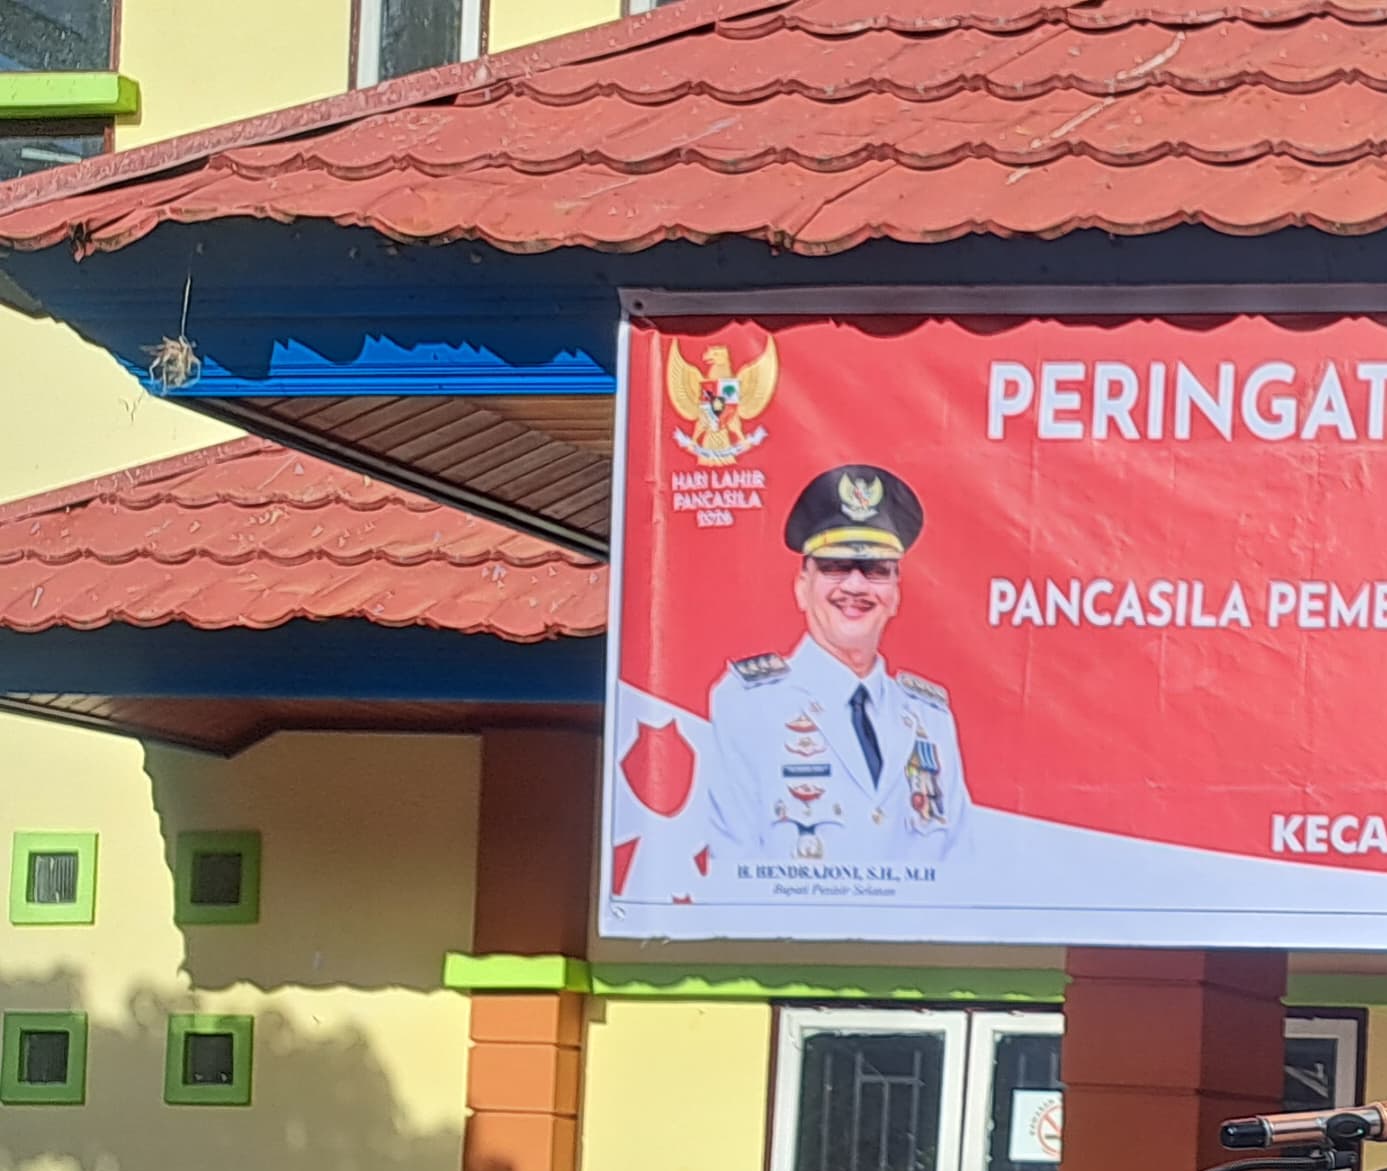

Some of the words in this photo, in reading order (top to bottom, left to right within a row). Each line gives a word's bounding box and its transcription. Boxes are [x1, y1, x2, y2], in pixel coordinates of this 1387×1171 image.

[711, 469, 766, 489] LAHIR
[673, 490, 763, 511] PANCASILA
[988, 577, 1252, 628] PANCASILA
